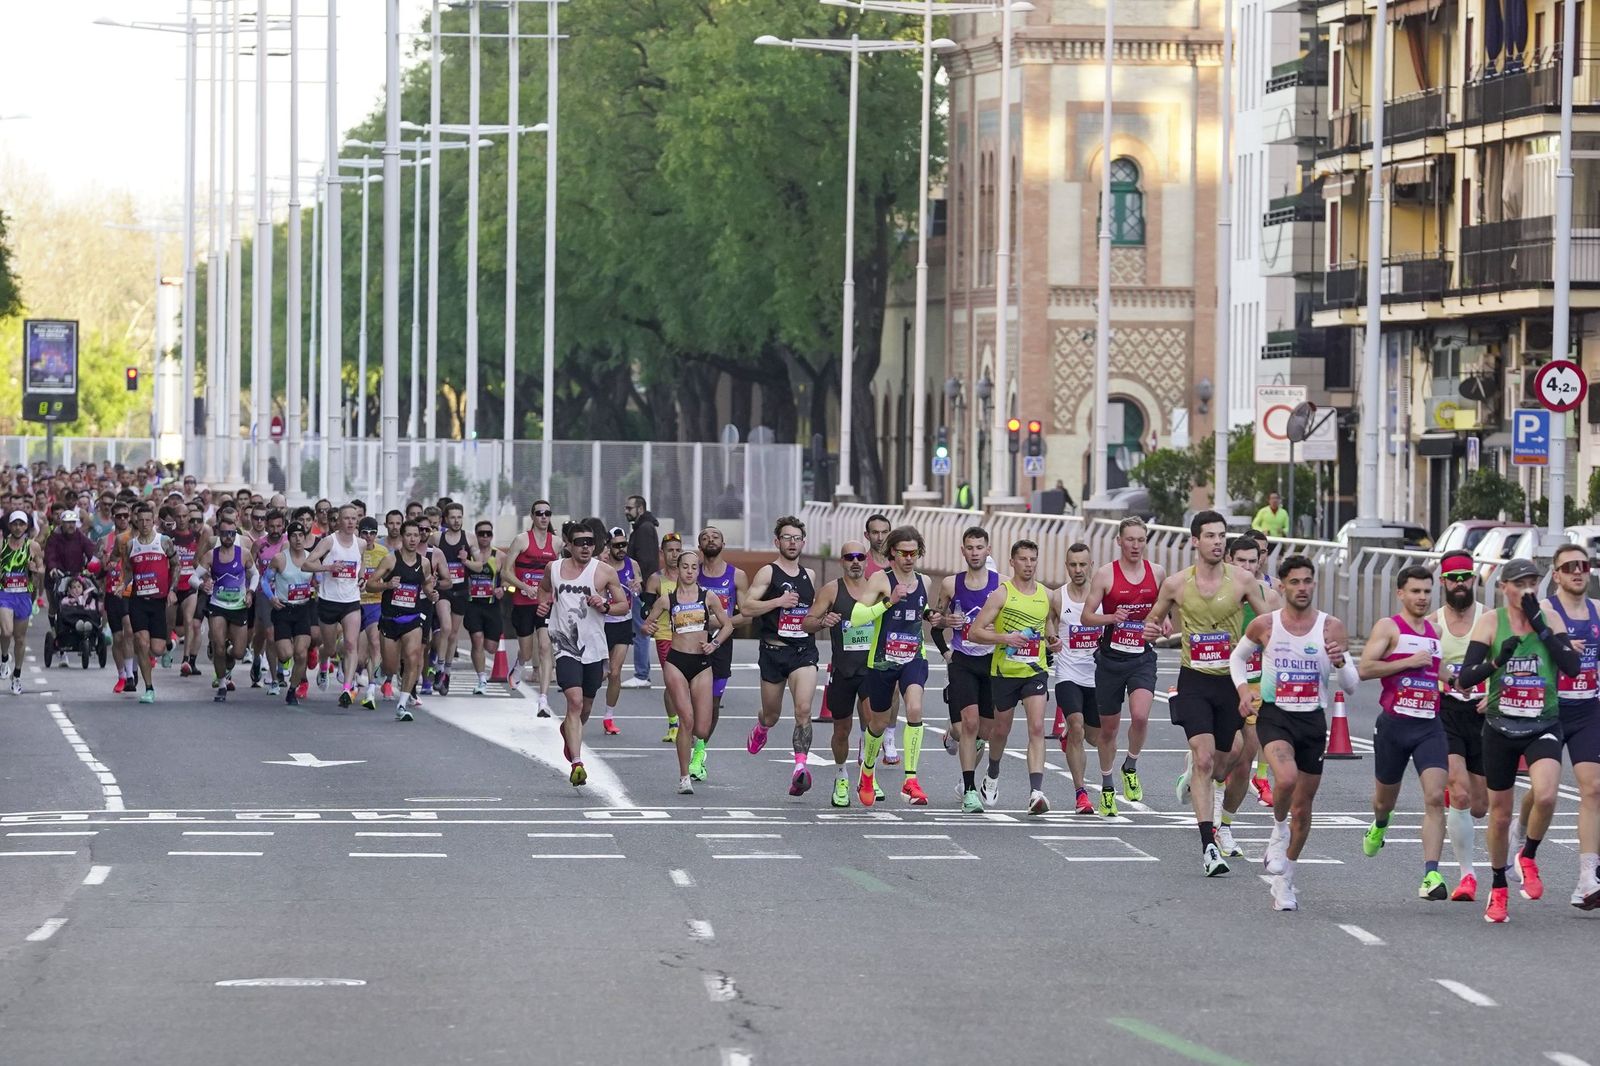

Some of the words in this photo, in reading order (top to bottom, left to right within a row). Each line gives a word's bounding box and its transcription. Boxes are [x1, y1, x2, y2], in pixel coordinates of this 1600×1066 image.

[1518, 414, 1541, 443] P
[851, 636, 869, 644] BART
[1076, 640, 1098, 648] RADEK
[1118, 637, 1140, 647] LUCAS
[1017, 648, 1032, 656] MAT
[1199, 651, 1222, 660] MARK
[1413, 680, 1435, 688] ZURICH
[1572, 680, 1588, 690] LÉO
[1396, 697, 1419, 708] JOSE
[1420, 700, 1436, 710] LUIS
[1499, 696, 1545, 708] SULLY-ALBA
